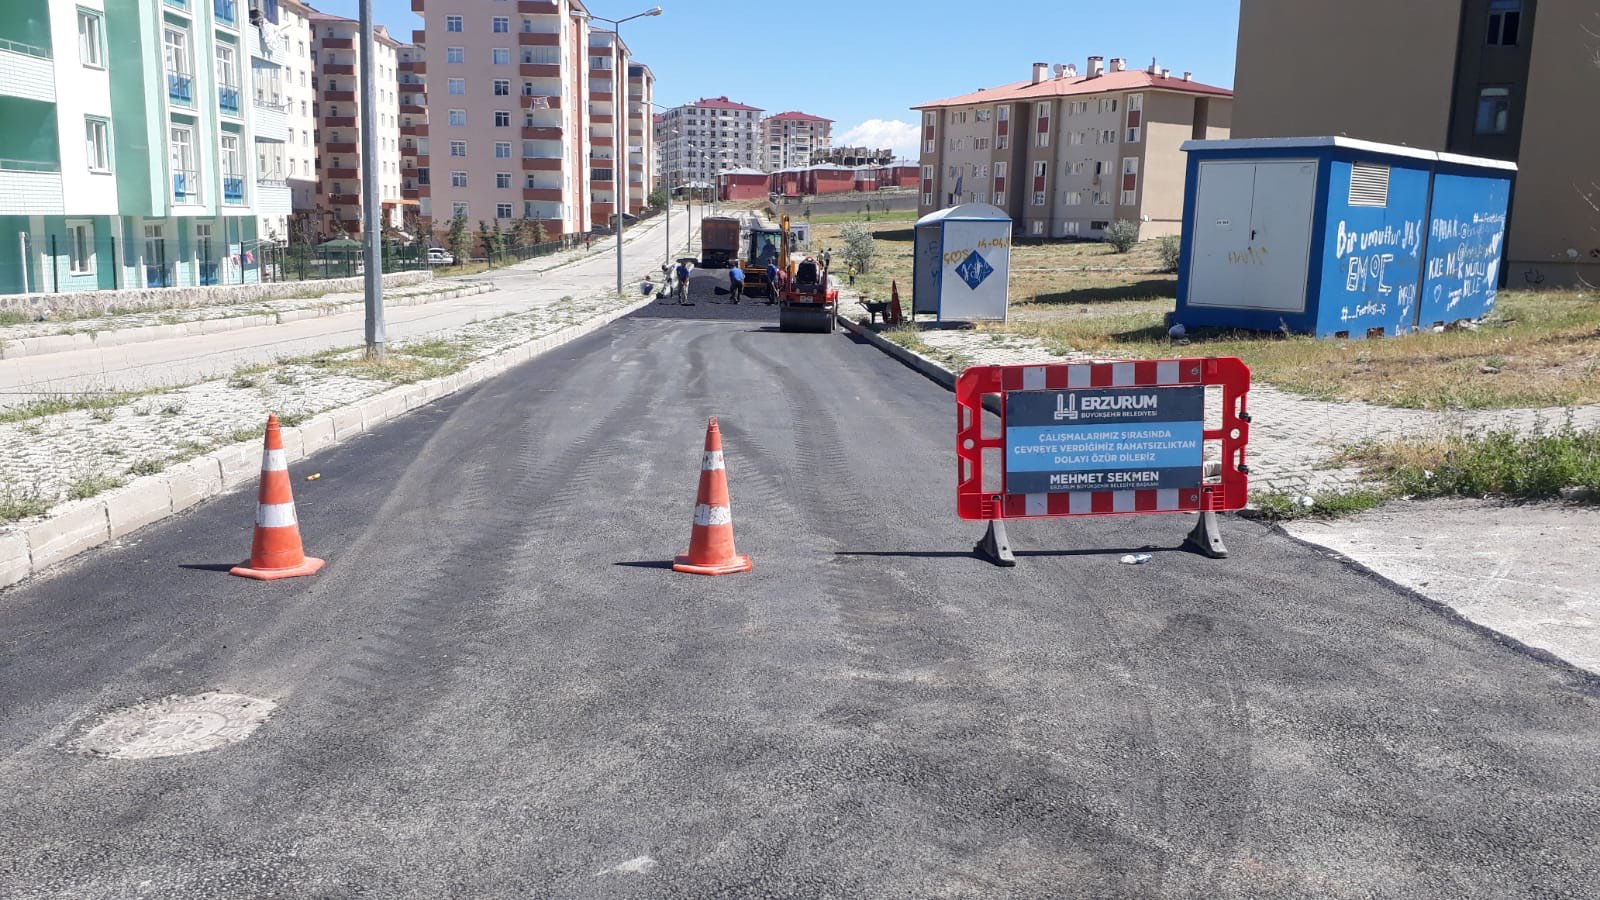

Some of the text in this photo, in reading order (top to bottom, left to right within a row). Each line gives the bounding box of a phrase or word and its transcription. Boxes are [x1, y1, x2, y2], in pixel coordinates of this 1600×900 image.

[1336, 220, 1357, 259] Bir
[1081, 395, 1158, 410] ERZURUM
[1081, 409, 1158, 419] BÜYÜKŞEHİR BELEDİYESİ
[1039, 430, 1171, 442] ÇALIŞMALARIMIZ SIRASINDA
[1014, 440, 1196, 455] ÇEVREYE VERDİĞİMİZ RAHATSIZLIKTAN
[1054, 452, 1156, 464] DOLAYI ÖZÜR DİLERİZ
[1050, 471, 1159, 484] MEHMET SEKMEN
